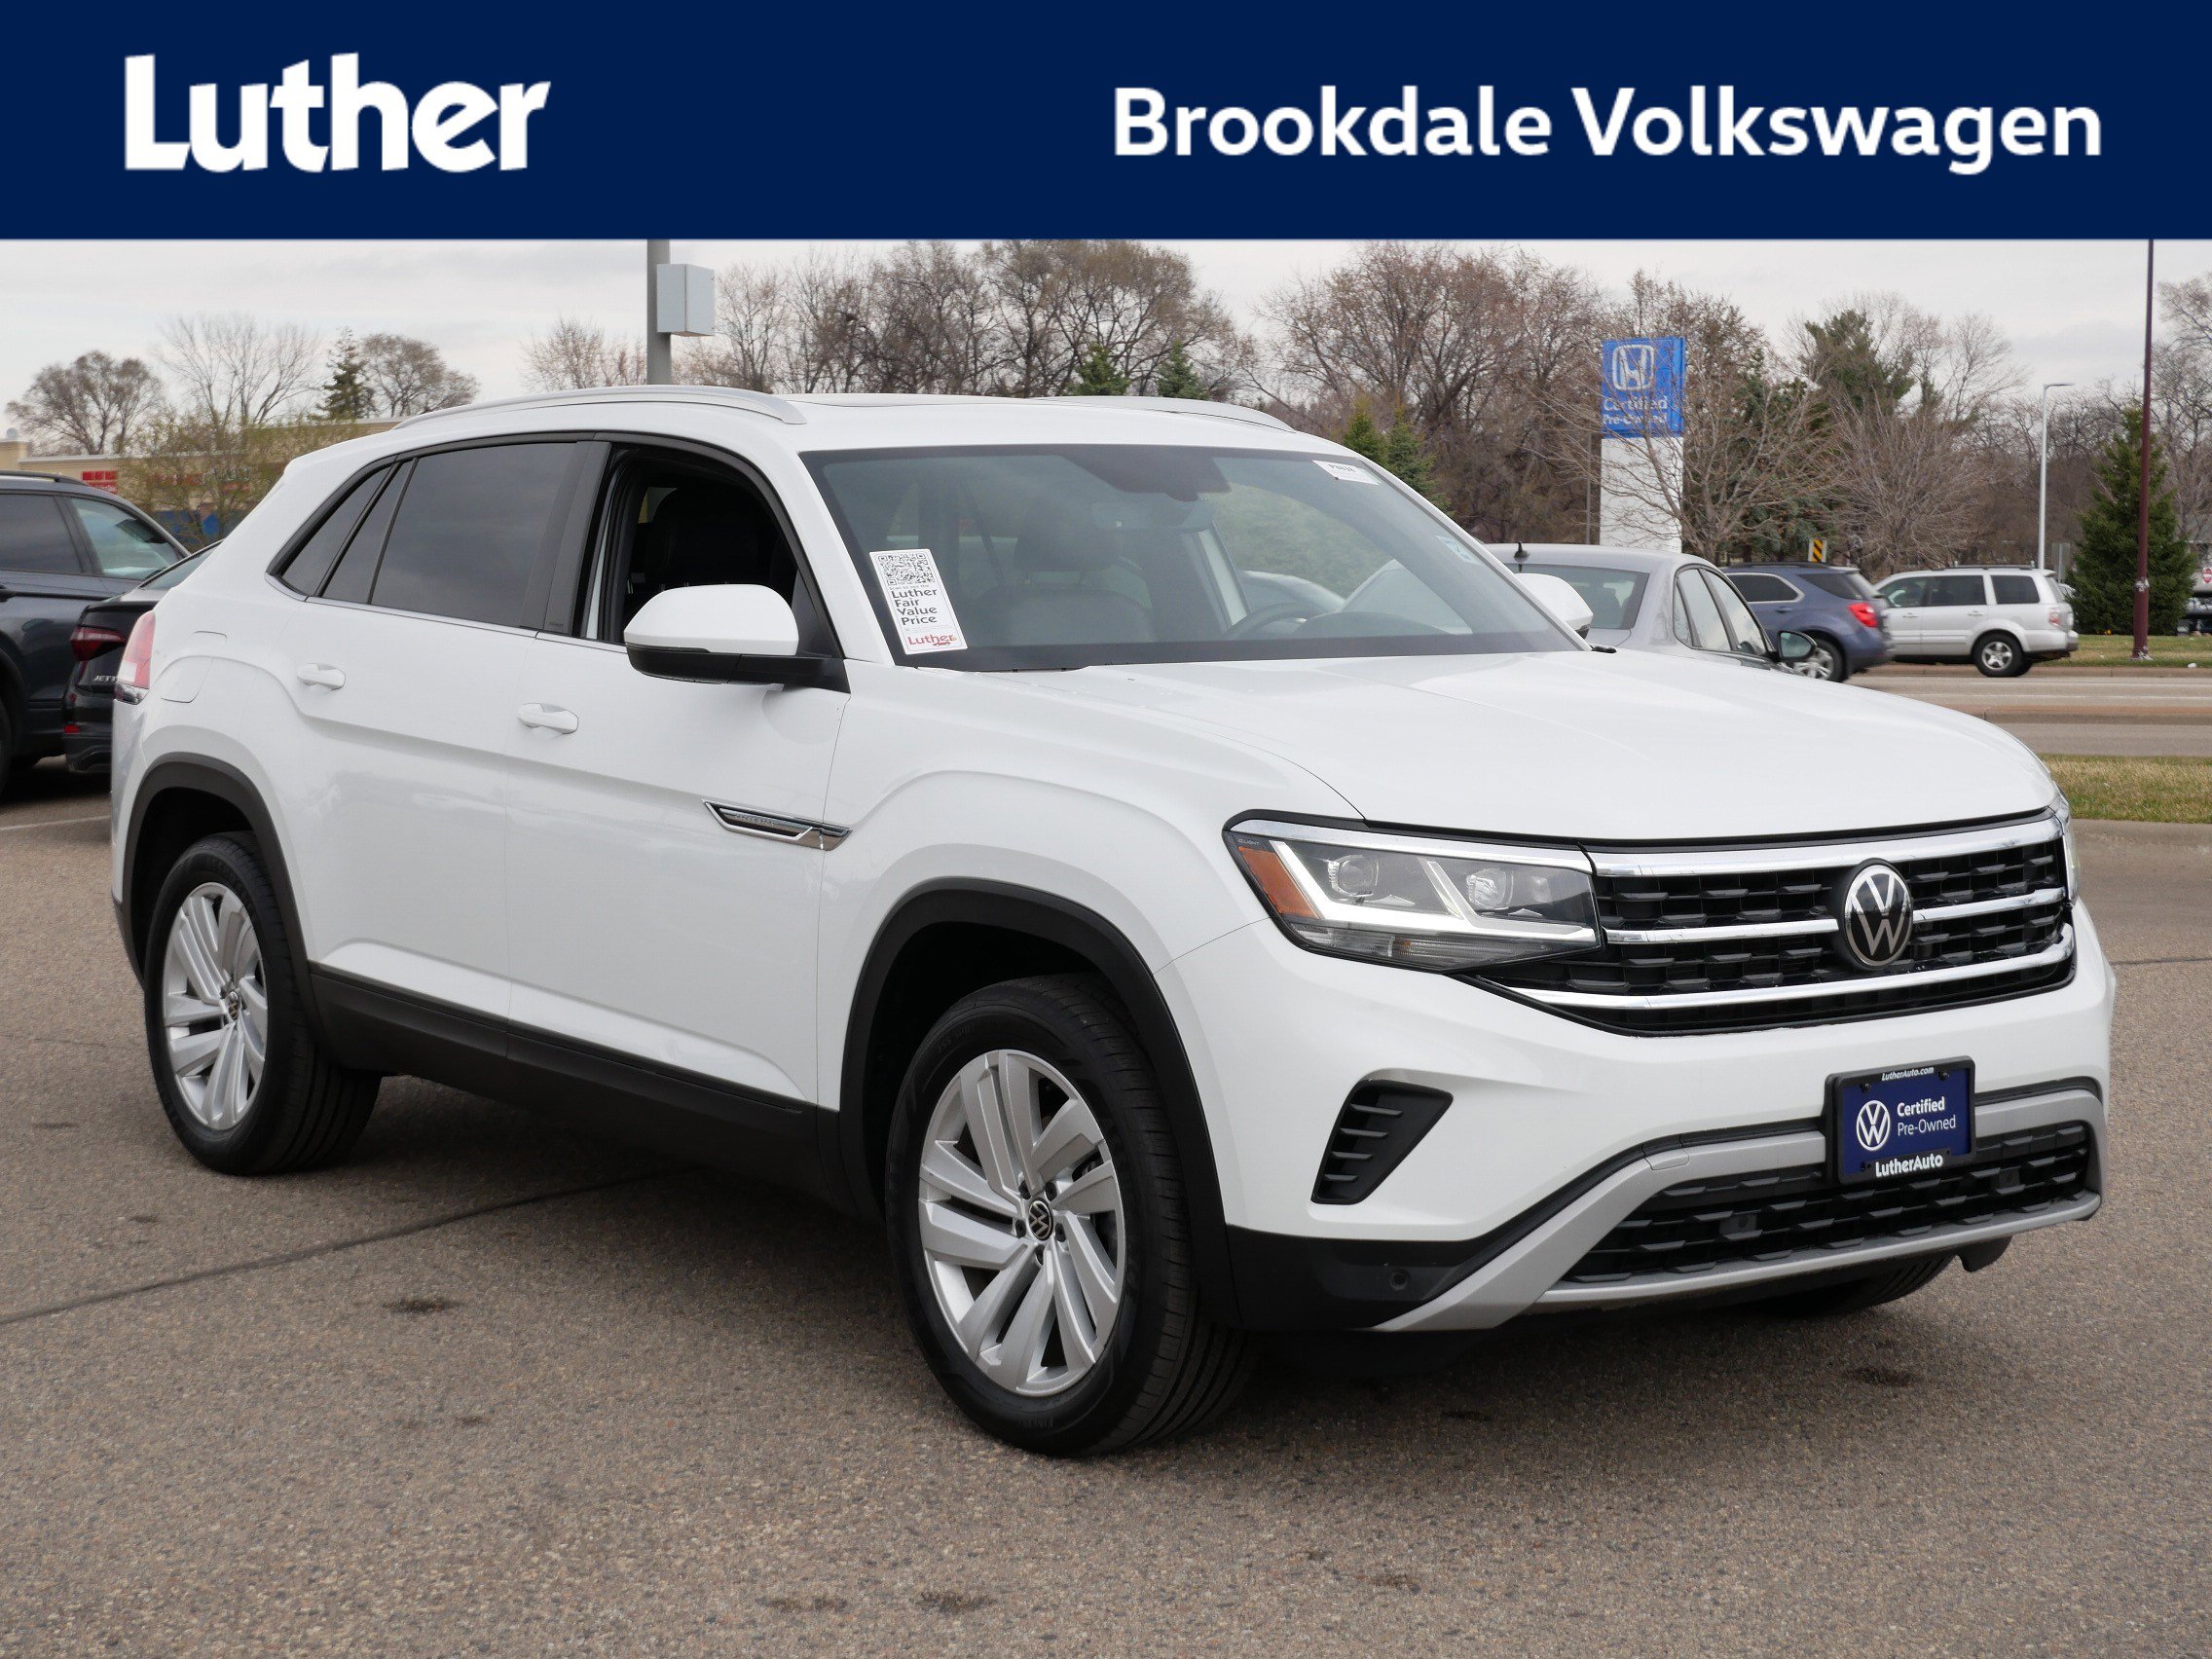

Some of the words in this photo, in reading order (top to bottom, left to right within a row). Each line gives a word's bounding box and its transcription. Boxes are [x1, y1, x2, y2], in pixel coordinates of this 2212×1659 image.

[891, 588, 938, 599] Luther
[894, 598, 920, 608] Fair
[896, 607, 938, 615] Value
[902, 616, 938, 625] Price
[906, 635, 954, 645] Luther
[1881, 1066, 1935, 1081] LutherAuto.com
[1898, 1096, 1945, 1117] Certified
[1898, 1114, 1956, 1136] Pre-Owned
[1875, 1153, 1944, 1178] LutherAuto
